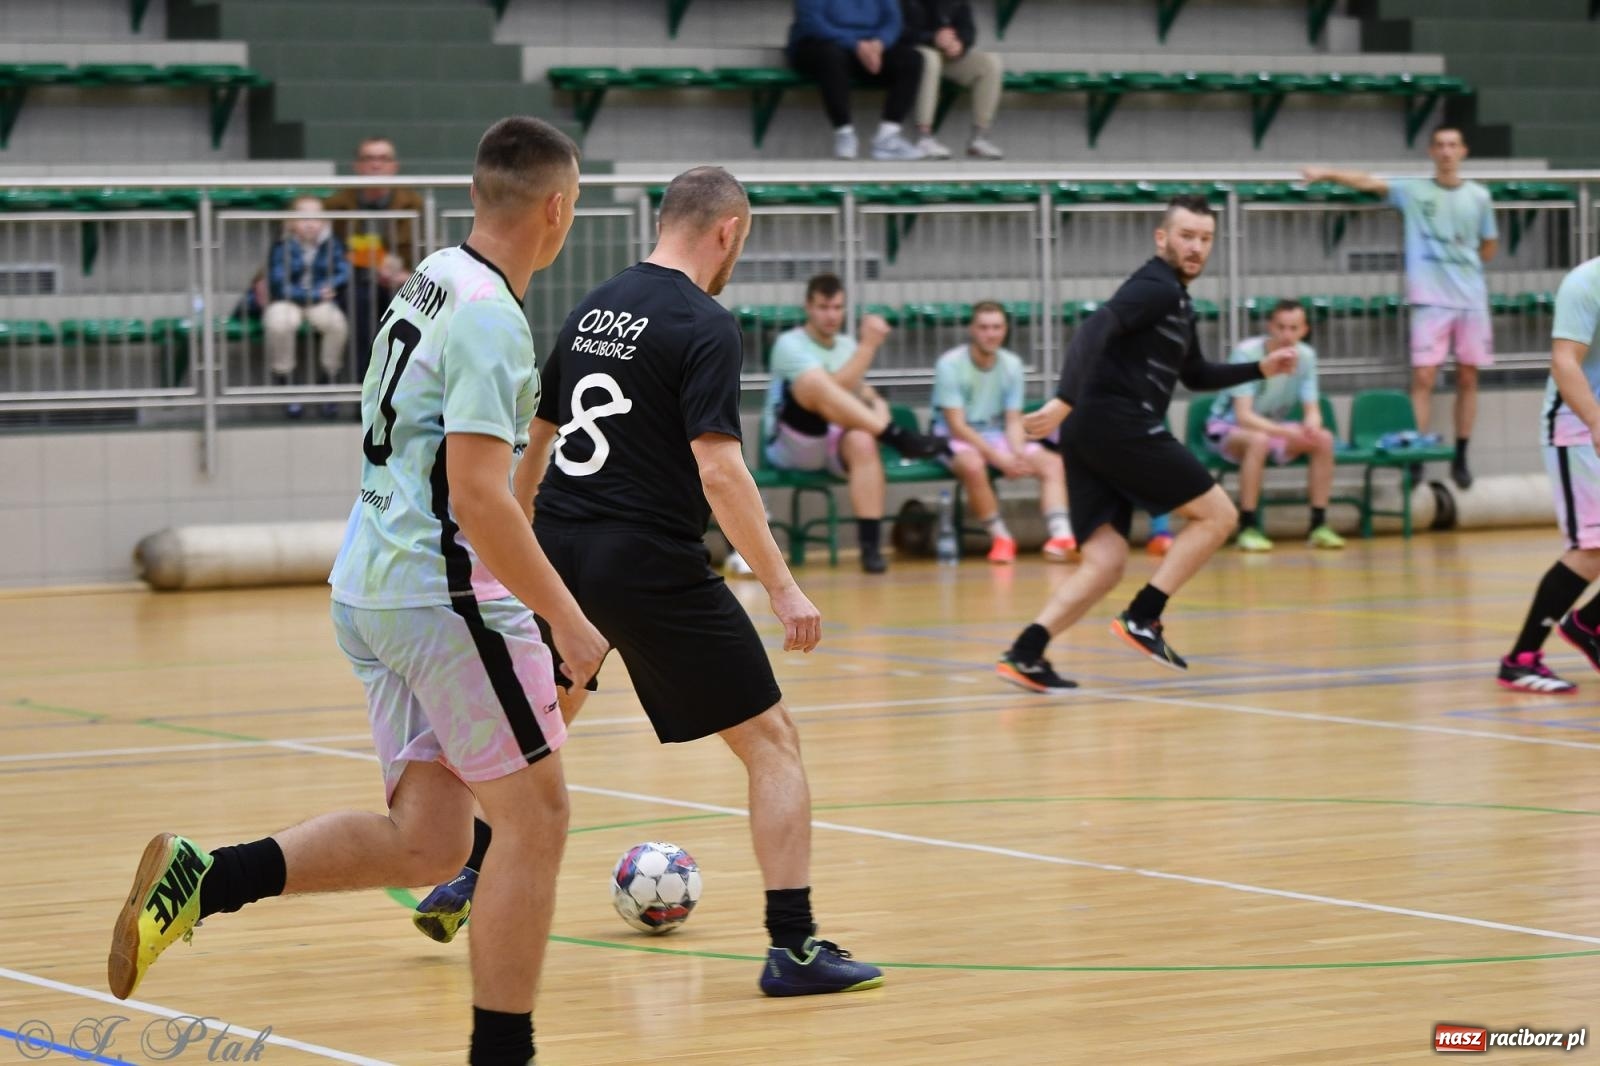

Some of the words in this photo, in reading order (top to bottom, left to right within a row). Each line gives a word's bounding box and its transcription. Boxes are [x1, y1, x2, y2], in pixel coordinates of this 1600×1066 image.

[571, 336, 637, 361] RACIBÓRZ
[578, 308, 649, 341] ODRA
[554, 372, 633, 477] 8
[146, 839, 209, 936] NIKE
